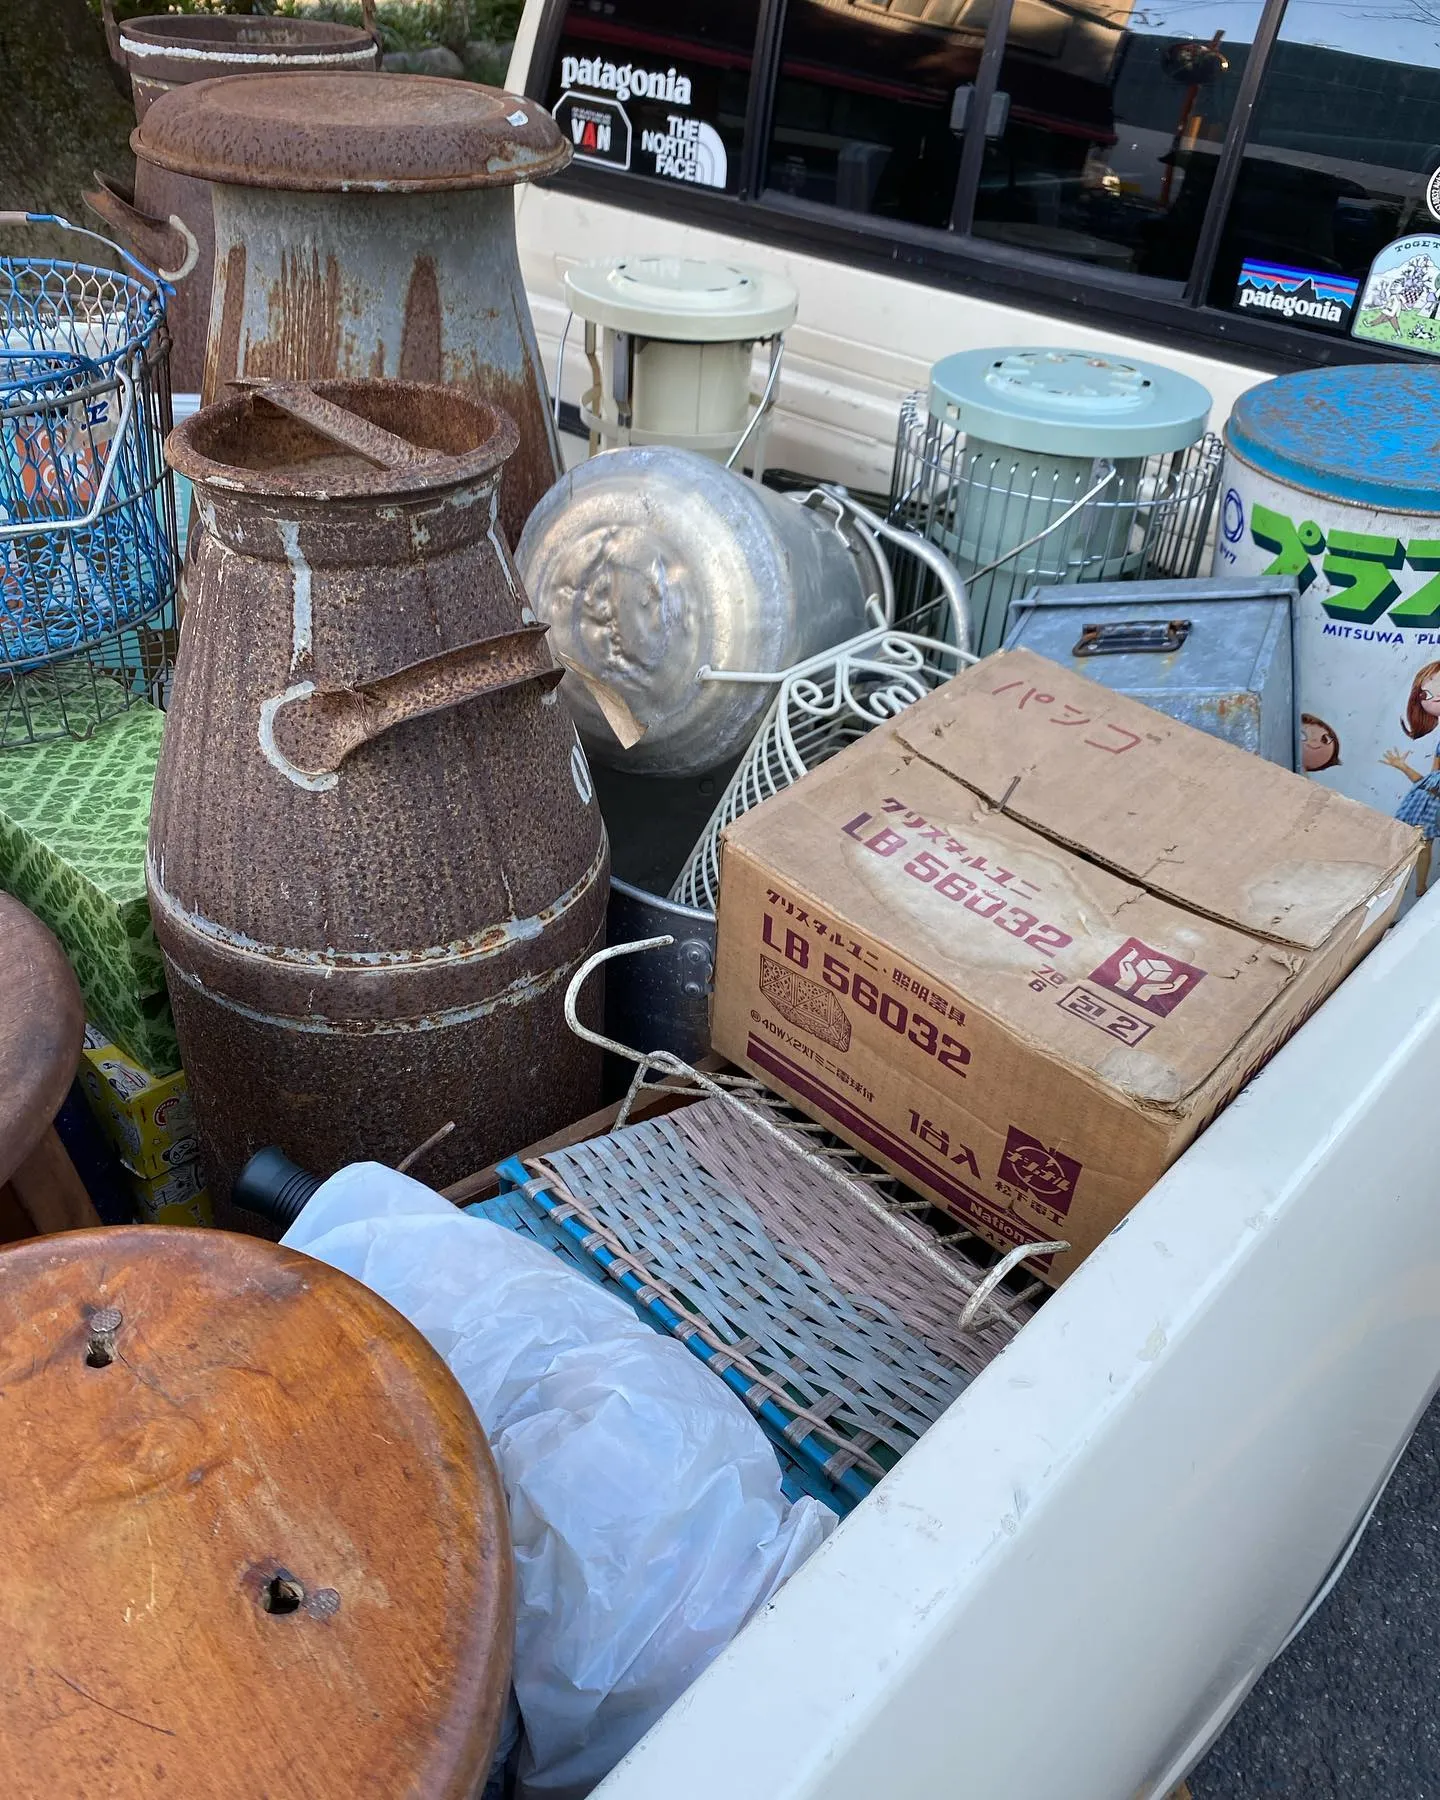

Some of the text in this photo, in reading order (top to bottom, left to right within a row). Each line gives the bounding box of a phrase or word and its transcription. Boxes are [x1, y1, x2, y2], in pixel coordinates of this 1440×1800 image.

[560, 56, 692, 105] patagonia
[570, 117, 612, 152] VAN
[640, 129, 699, 161] NORTH
[666, 114, 699, 142] THE
[655, 153, 699, 182] FACE
[1237, 287, 1343, 323] patagonia
[1322, 623, 1405, 645] MITSUWA
[840, 811, 1075, 959] LB 56032
[762, 912, 972, 1079] LB 56032
[970, 1201, 1034, 1246] Nation
